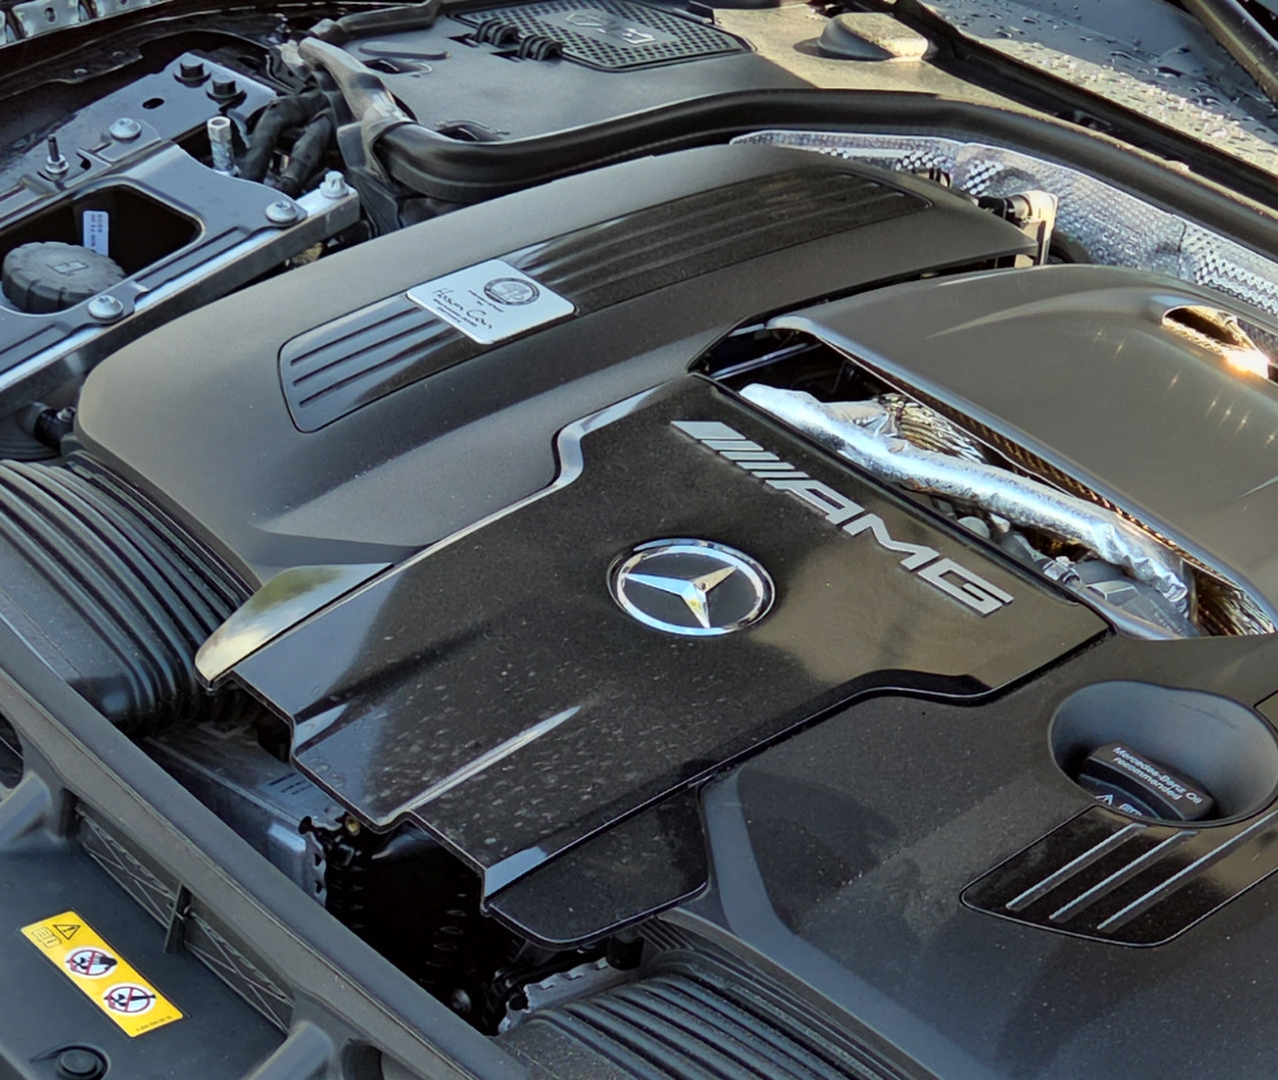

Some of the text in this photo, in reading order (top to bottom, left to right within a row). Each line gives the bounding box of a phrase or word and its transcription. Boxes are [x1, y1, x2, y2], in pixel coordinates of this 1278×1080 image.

[765, 479, 1014, 617] AMG
[1113, 747, 1203, 804] Mercedes-Benz Oil
[1113, 757, 1183, 800] recommended
